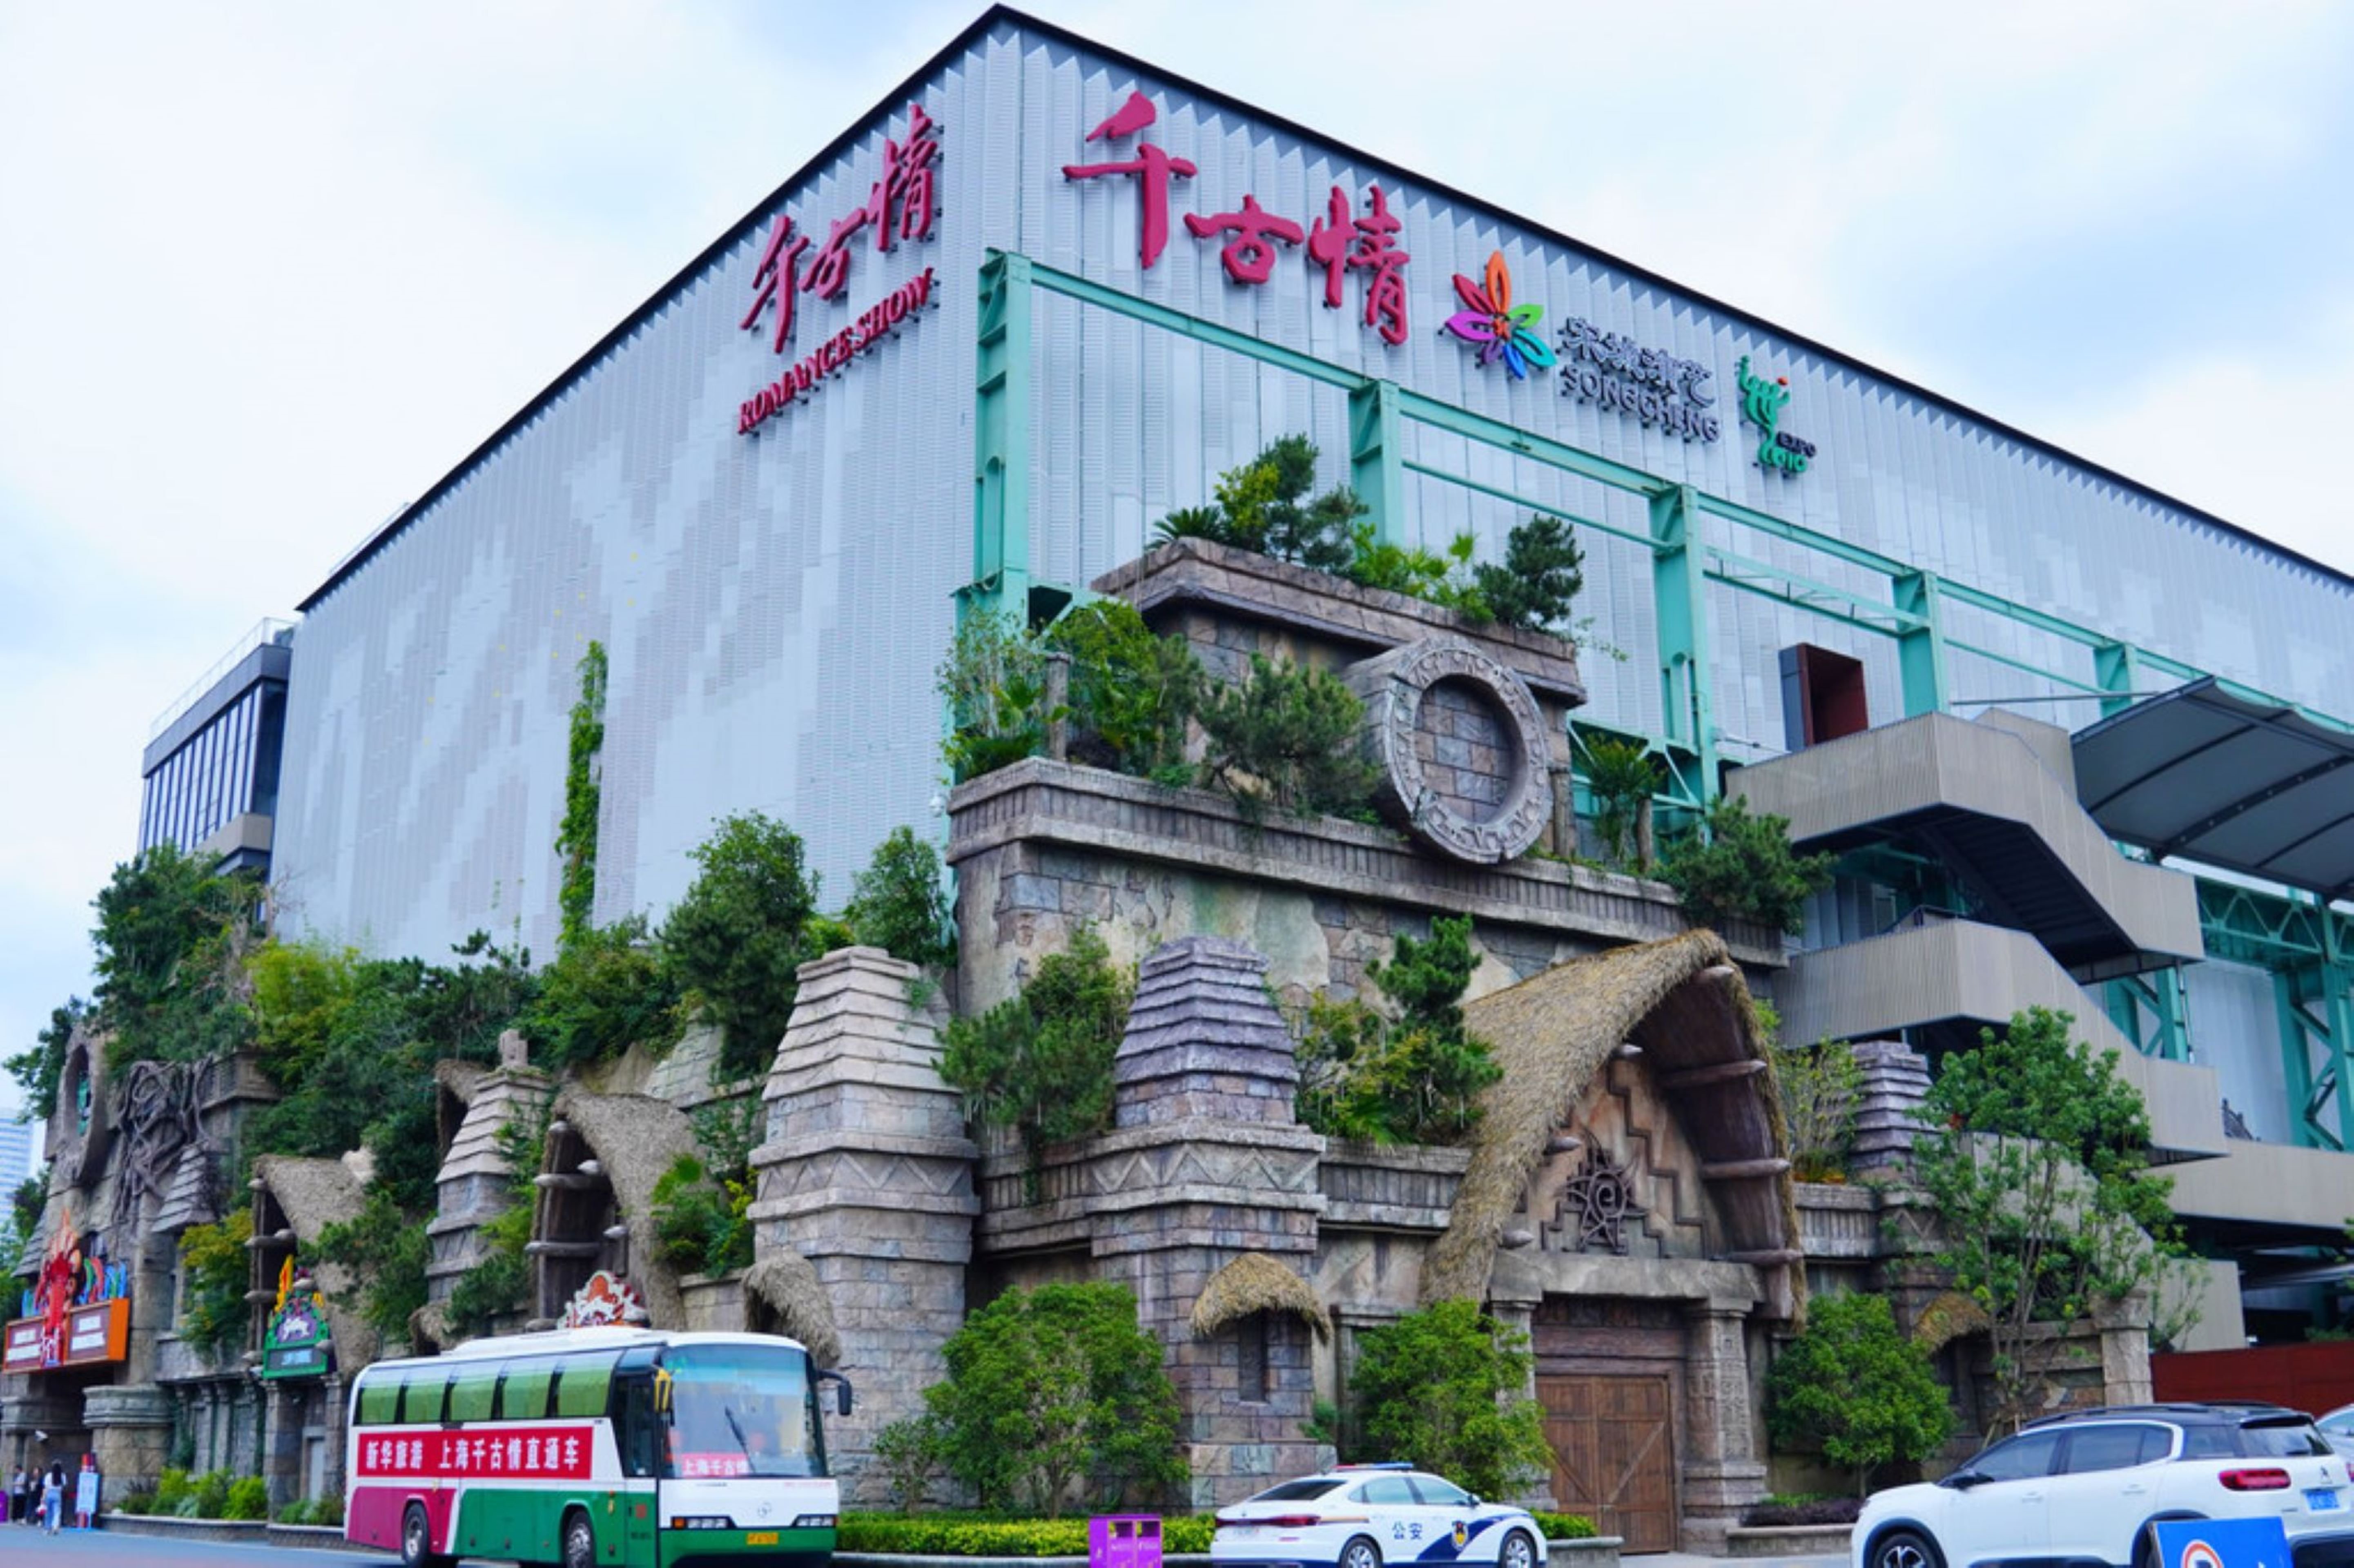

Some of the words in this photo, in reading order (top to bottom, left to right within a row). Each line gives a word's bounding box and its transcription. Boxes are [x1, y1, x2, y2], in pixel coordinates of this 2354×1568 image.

[740, 103, 938, 354] 千古情
[1063, 90, 1411, 346] 千古情
[738, 326, 854, 434] ROMANCE
[854, 267, 934, 351] SHOW
[1560, 365, 1721, 443] SONGCHENG
[1392, 1521, 1422, 1540] 公安
